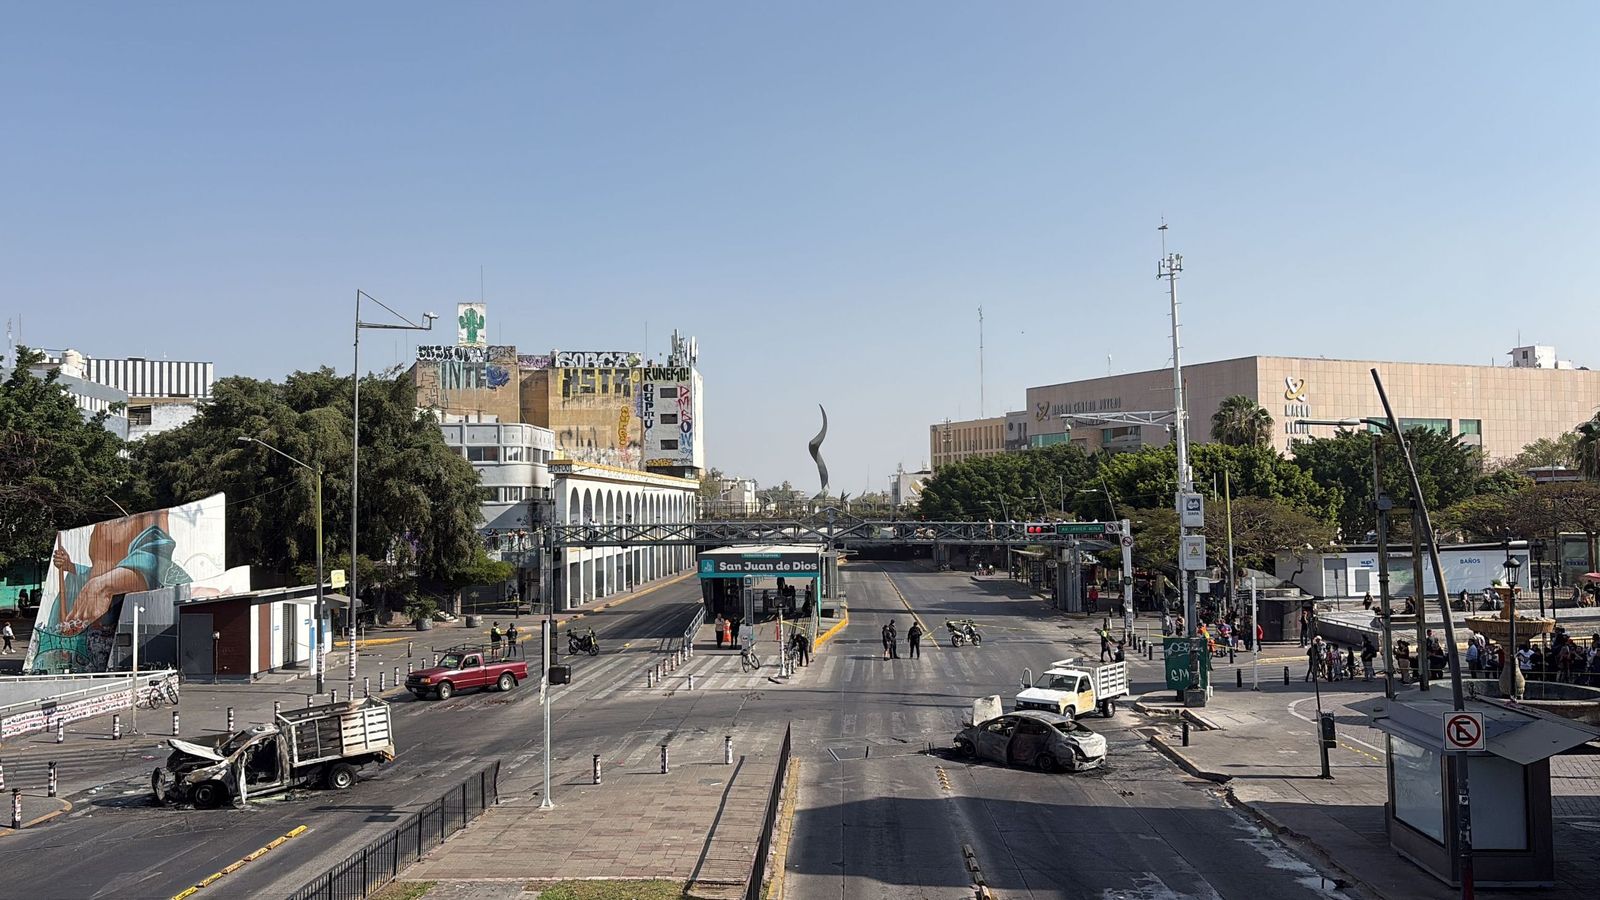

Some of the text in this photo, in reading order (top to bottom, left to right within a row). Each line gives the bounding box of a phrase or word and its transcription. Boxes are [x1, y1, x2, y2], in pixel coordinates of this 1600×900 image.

[1459, 557, 1481, 565] BAÑOS
[719, 561, 818, 571] San Juan de Dios
